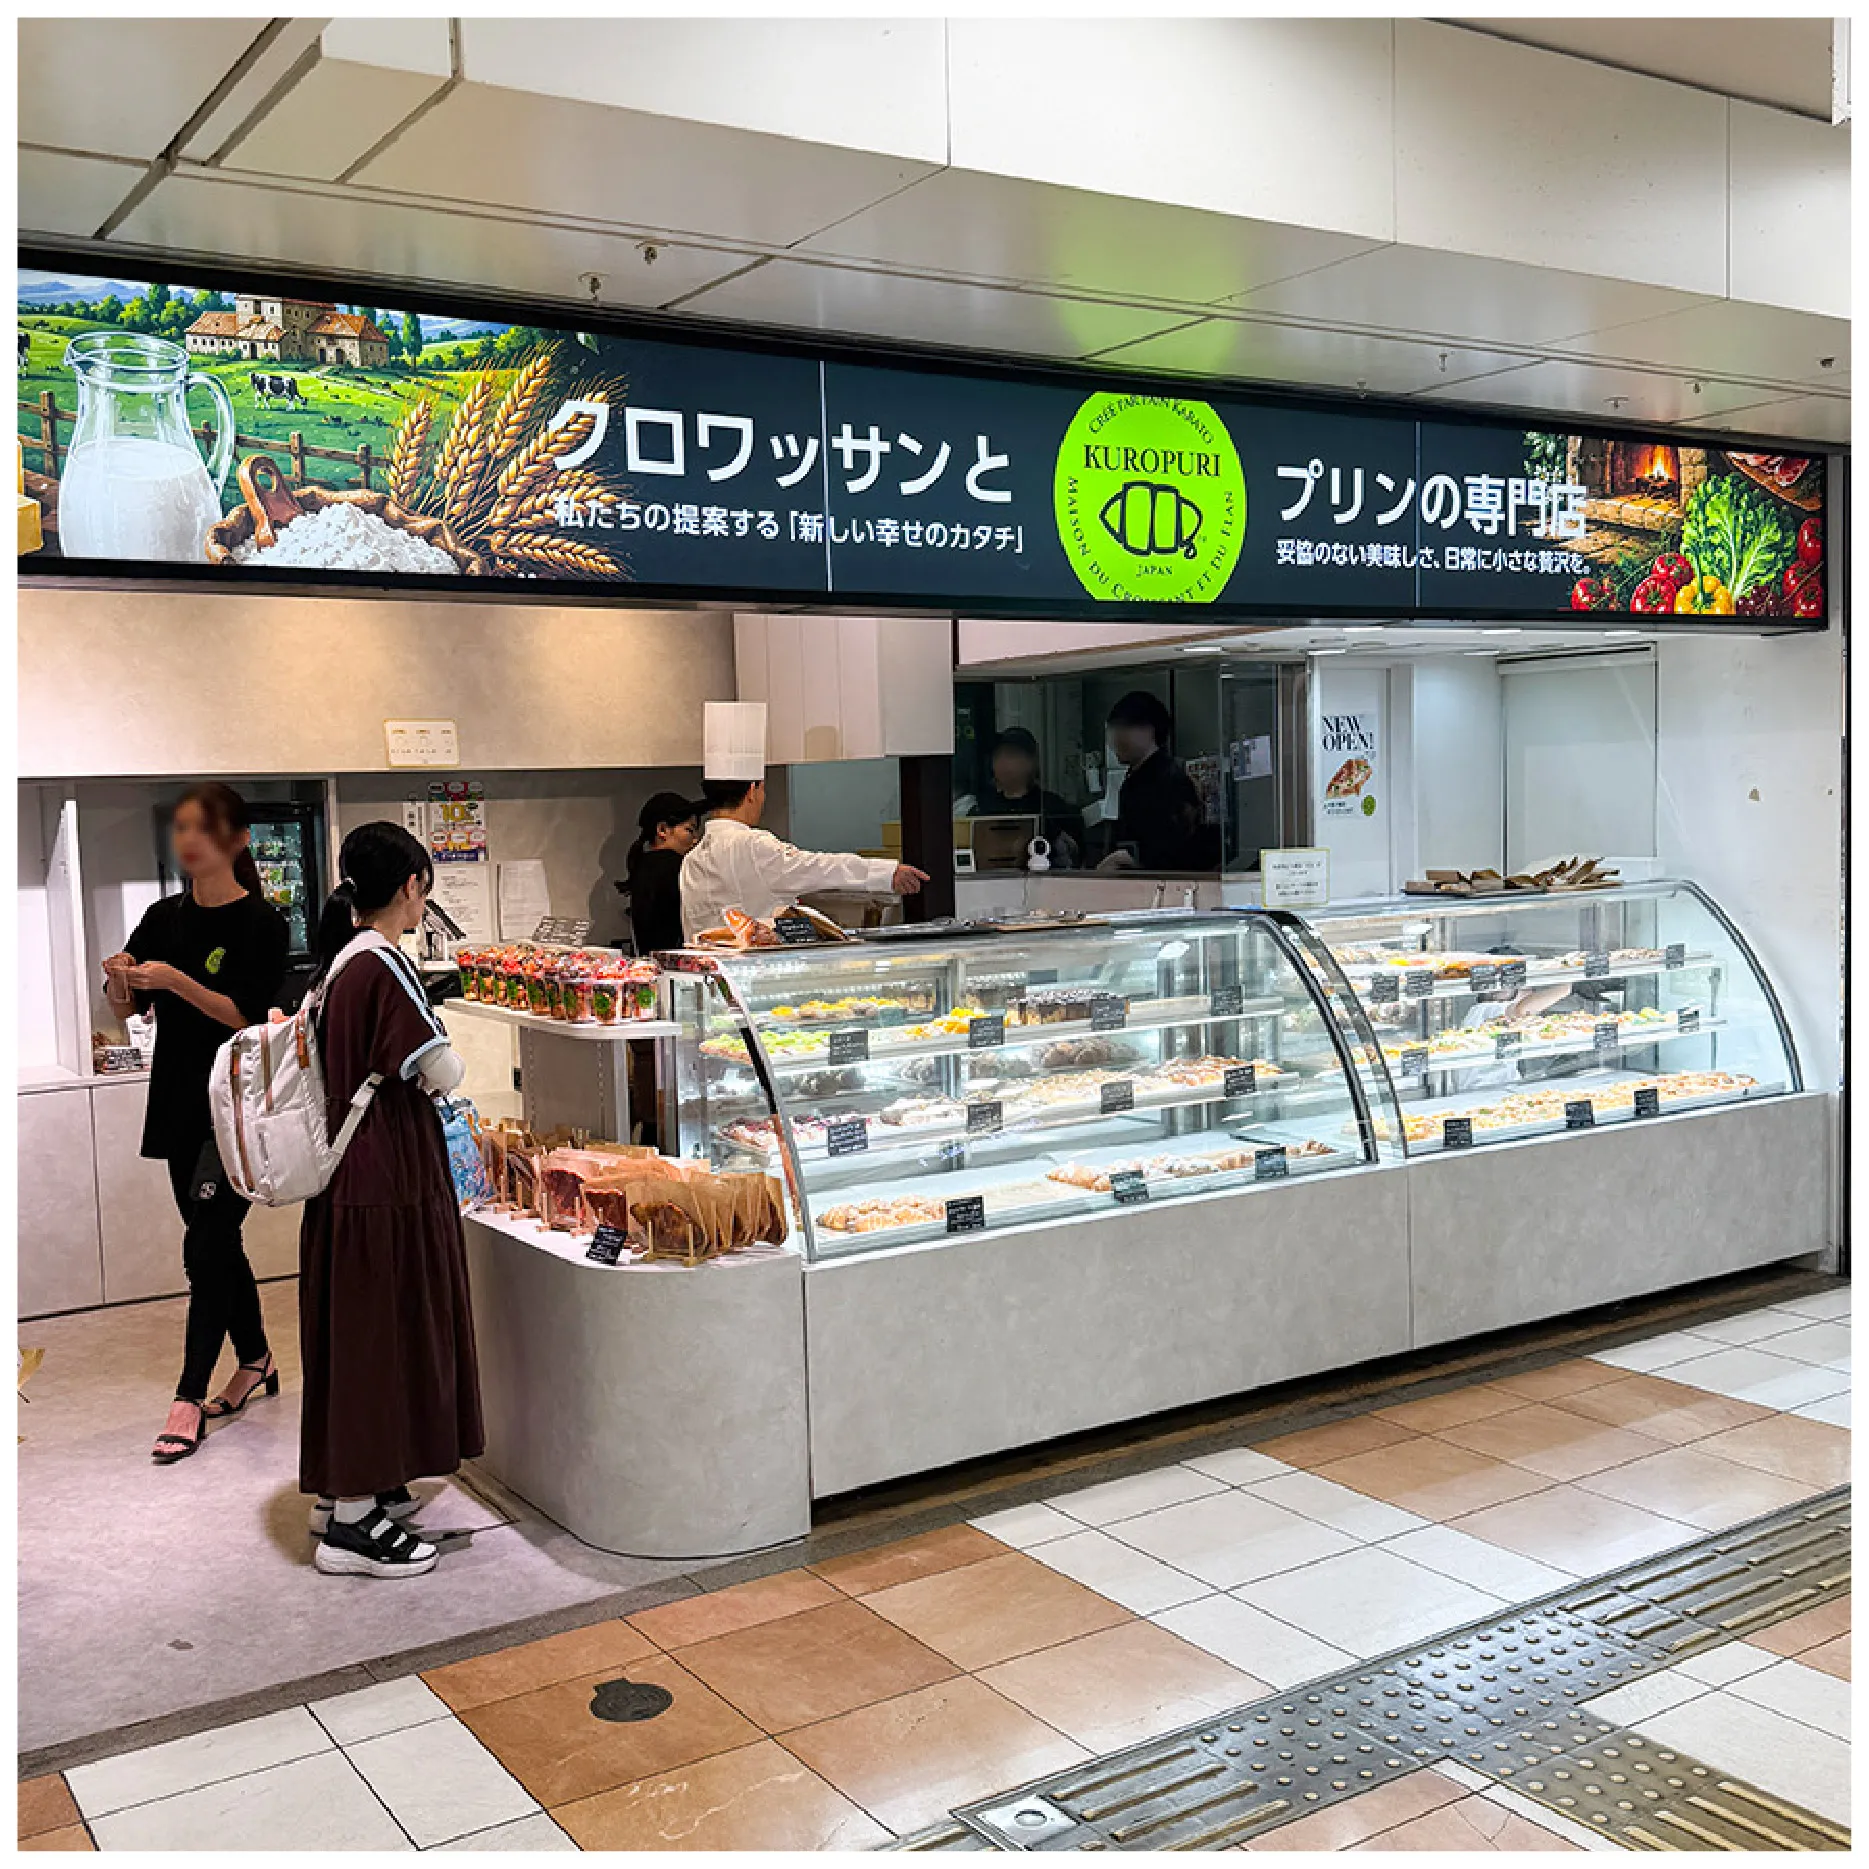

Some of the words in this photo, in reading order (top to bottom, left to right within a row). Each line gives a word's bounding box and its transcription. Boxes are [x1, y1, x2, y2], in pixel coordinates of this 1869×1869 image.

[547, 401, 1012, 503] クロワッサンと
[1084, 444, 1220, 478] KUROPURI
[1276, 457, 1587, 538] プリンの専門店
[1067, 476, 1091, 556] MAISON
[1088, 560, 1109, 584] DU
[1135, 565, 1172, 578] JAPAN
[1322, 715, 1362, 732] NEW
[1321, 732, 1374, 750] OPEN!
